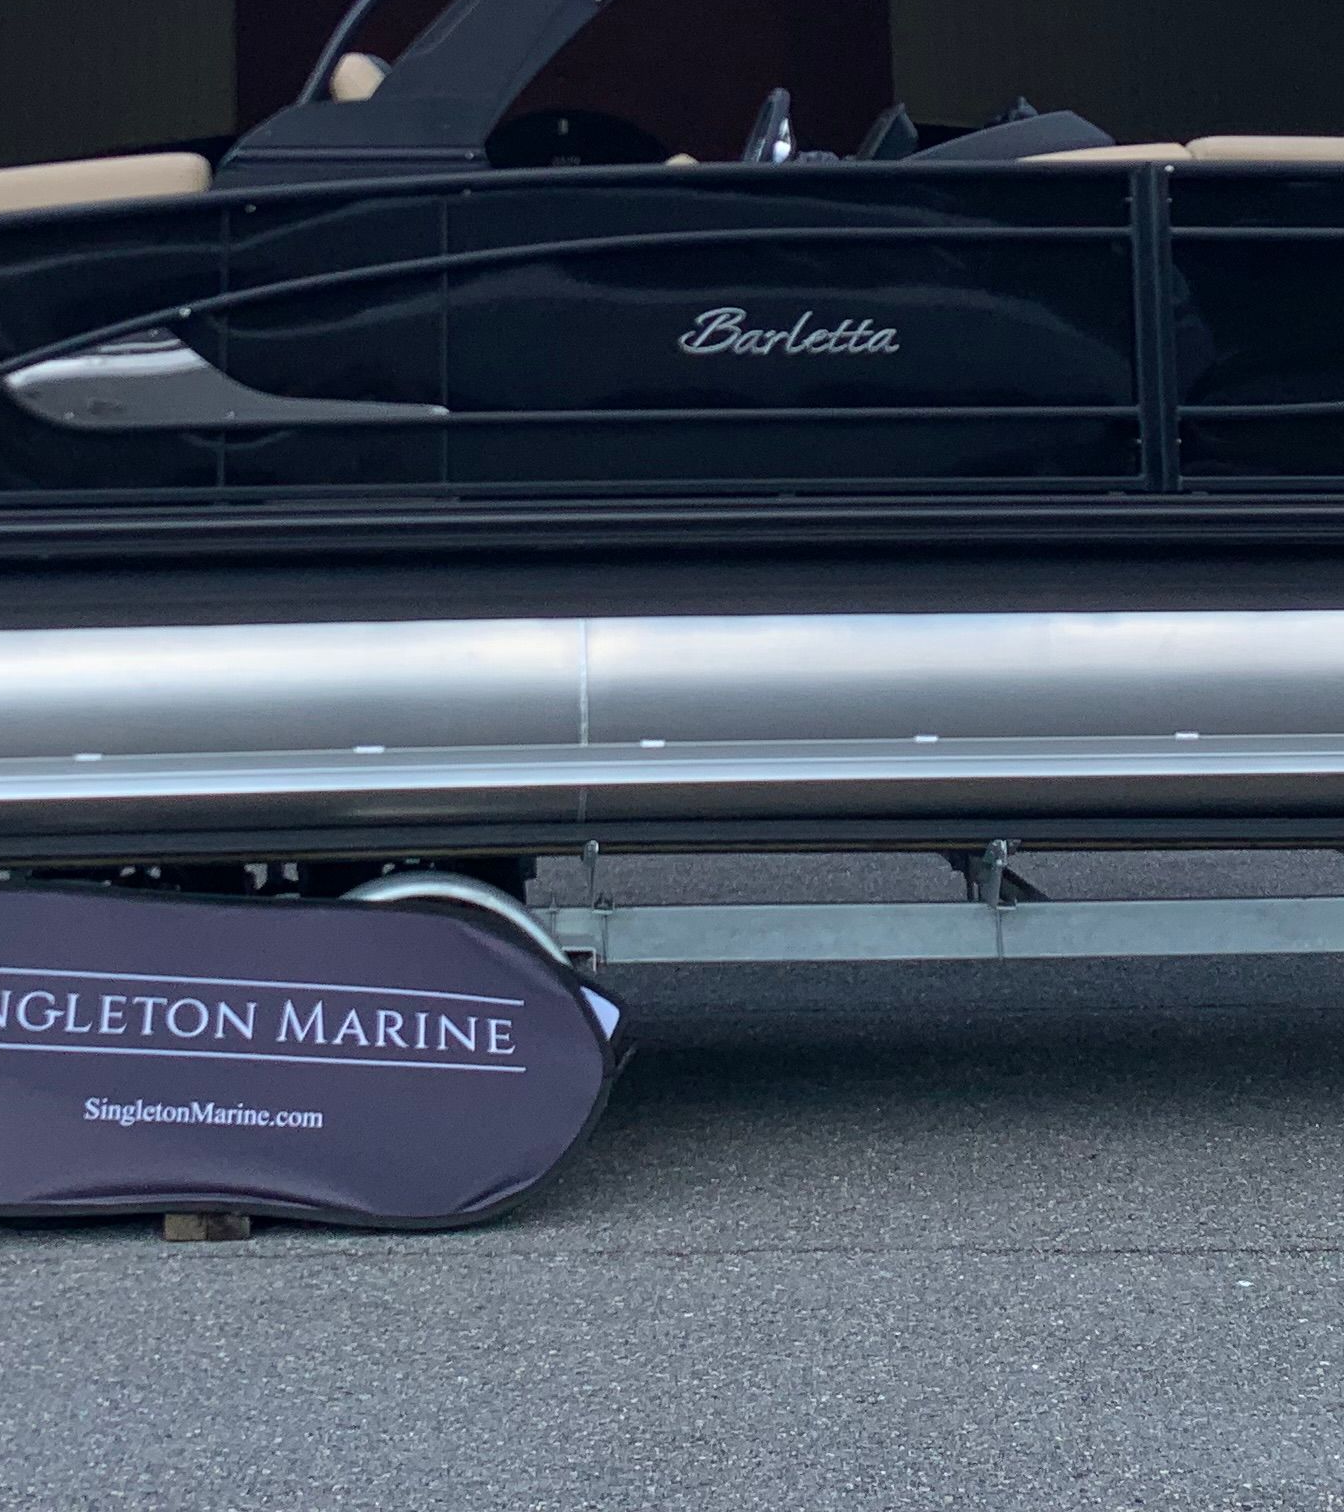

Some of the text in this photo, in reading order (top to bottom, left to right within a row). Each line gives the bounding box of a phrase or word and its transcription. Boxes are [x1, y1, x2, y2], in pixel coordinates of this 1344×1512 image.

[678, 306, 900, 355] Barletta
[276, 999, 516, 1055] MARINE
[83, 1097, 323, 1128] SingletonMarine.com
